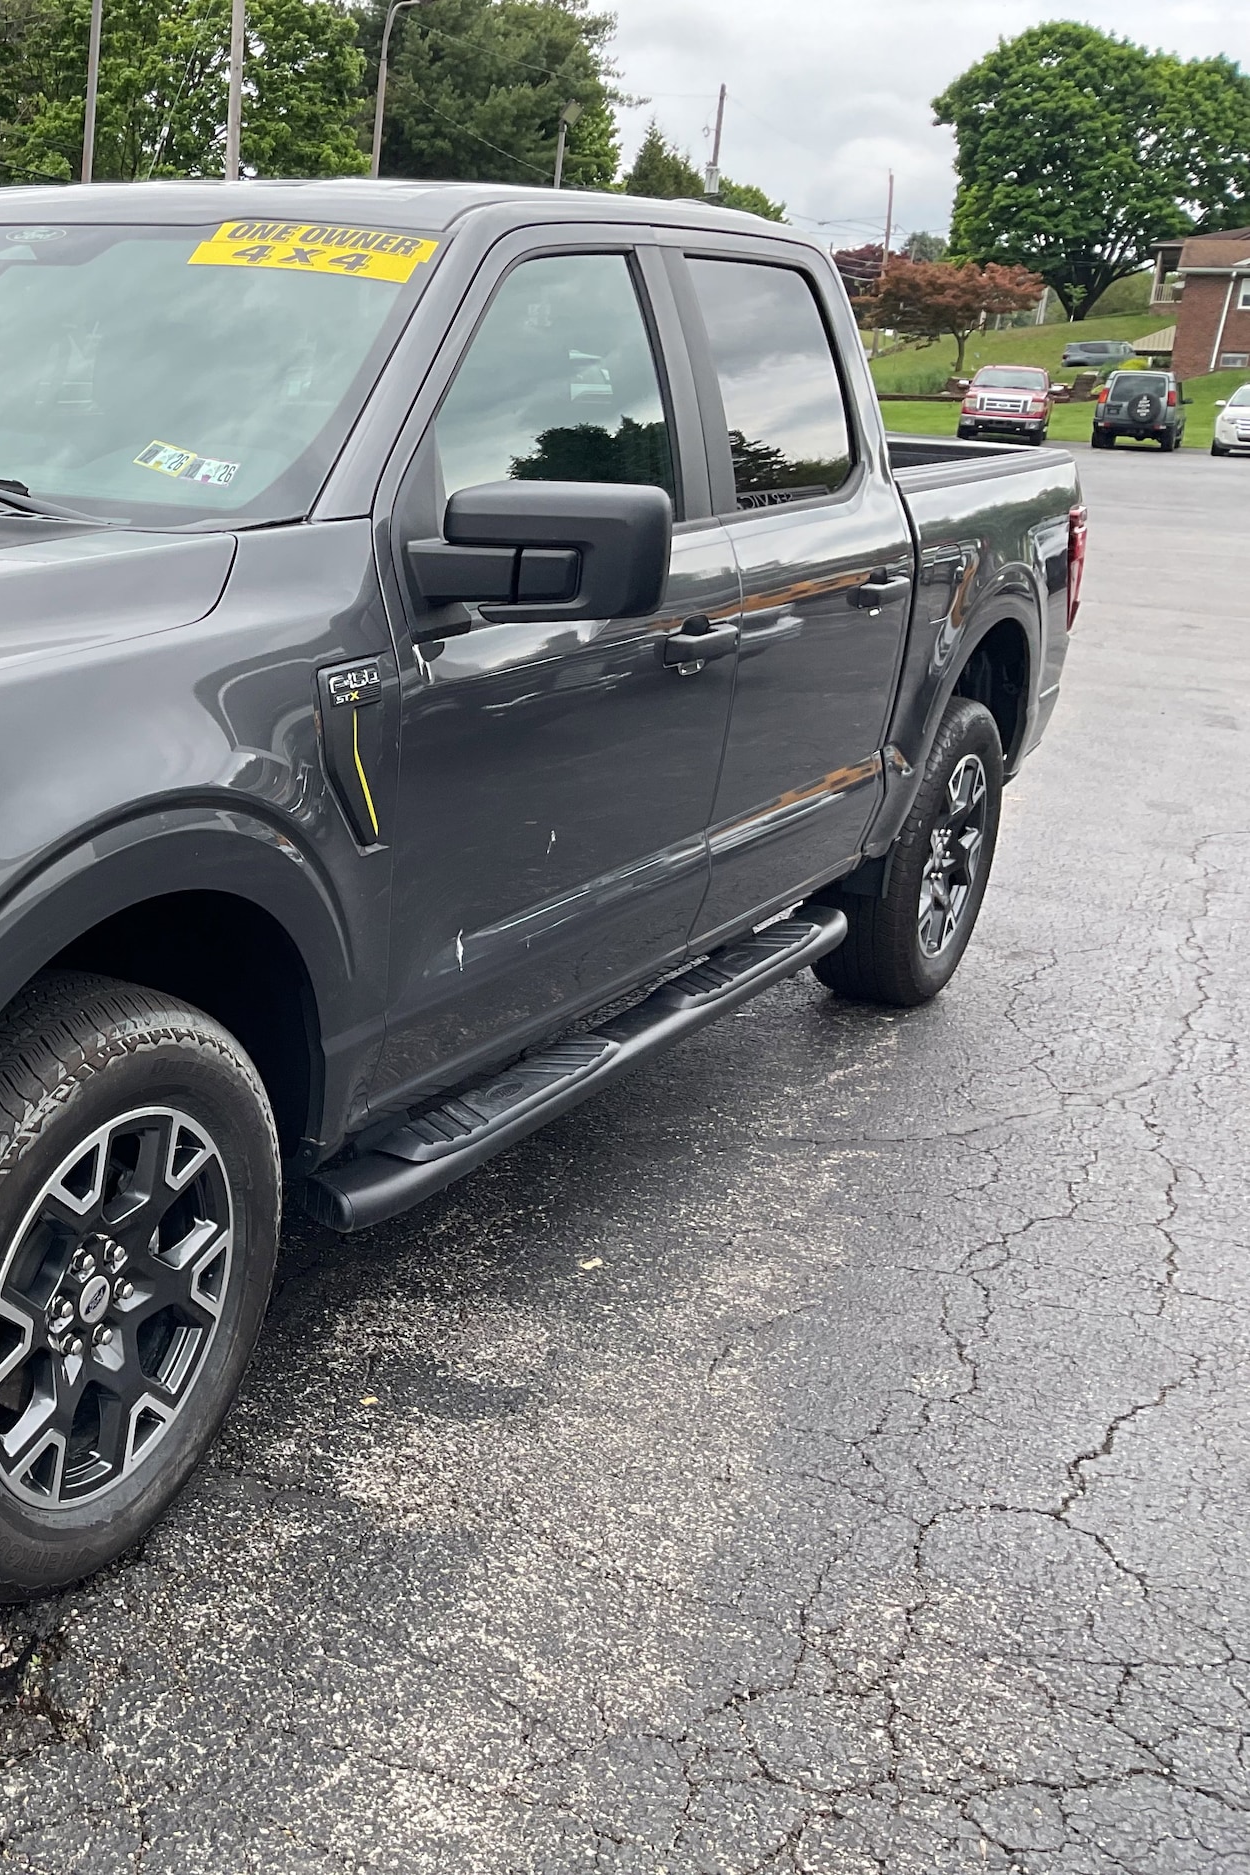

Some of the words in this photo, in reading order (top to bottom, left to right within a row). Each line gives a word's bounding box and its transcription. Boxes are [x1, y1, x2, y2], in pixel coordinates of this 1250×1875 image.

[227, 223, 301, 243] ONE
[300, 227, 423, 257] OWNER
[167, 453, 190, 471] 26
[217, 464, 237, 483] 26
[335, 690, 360, 704] STX
